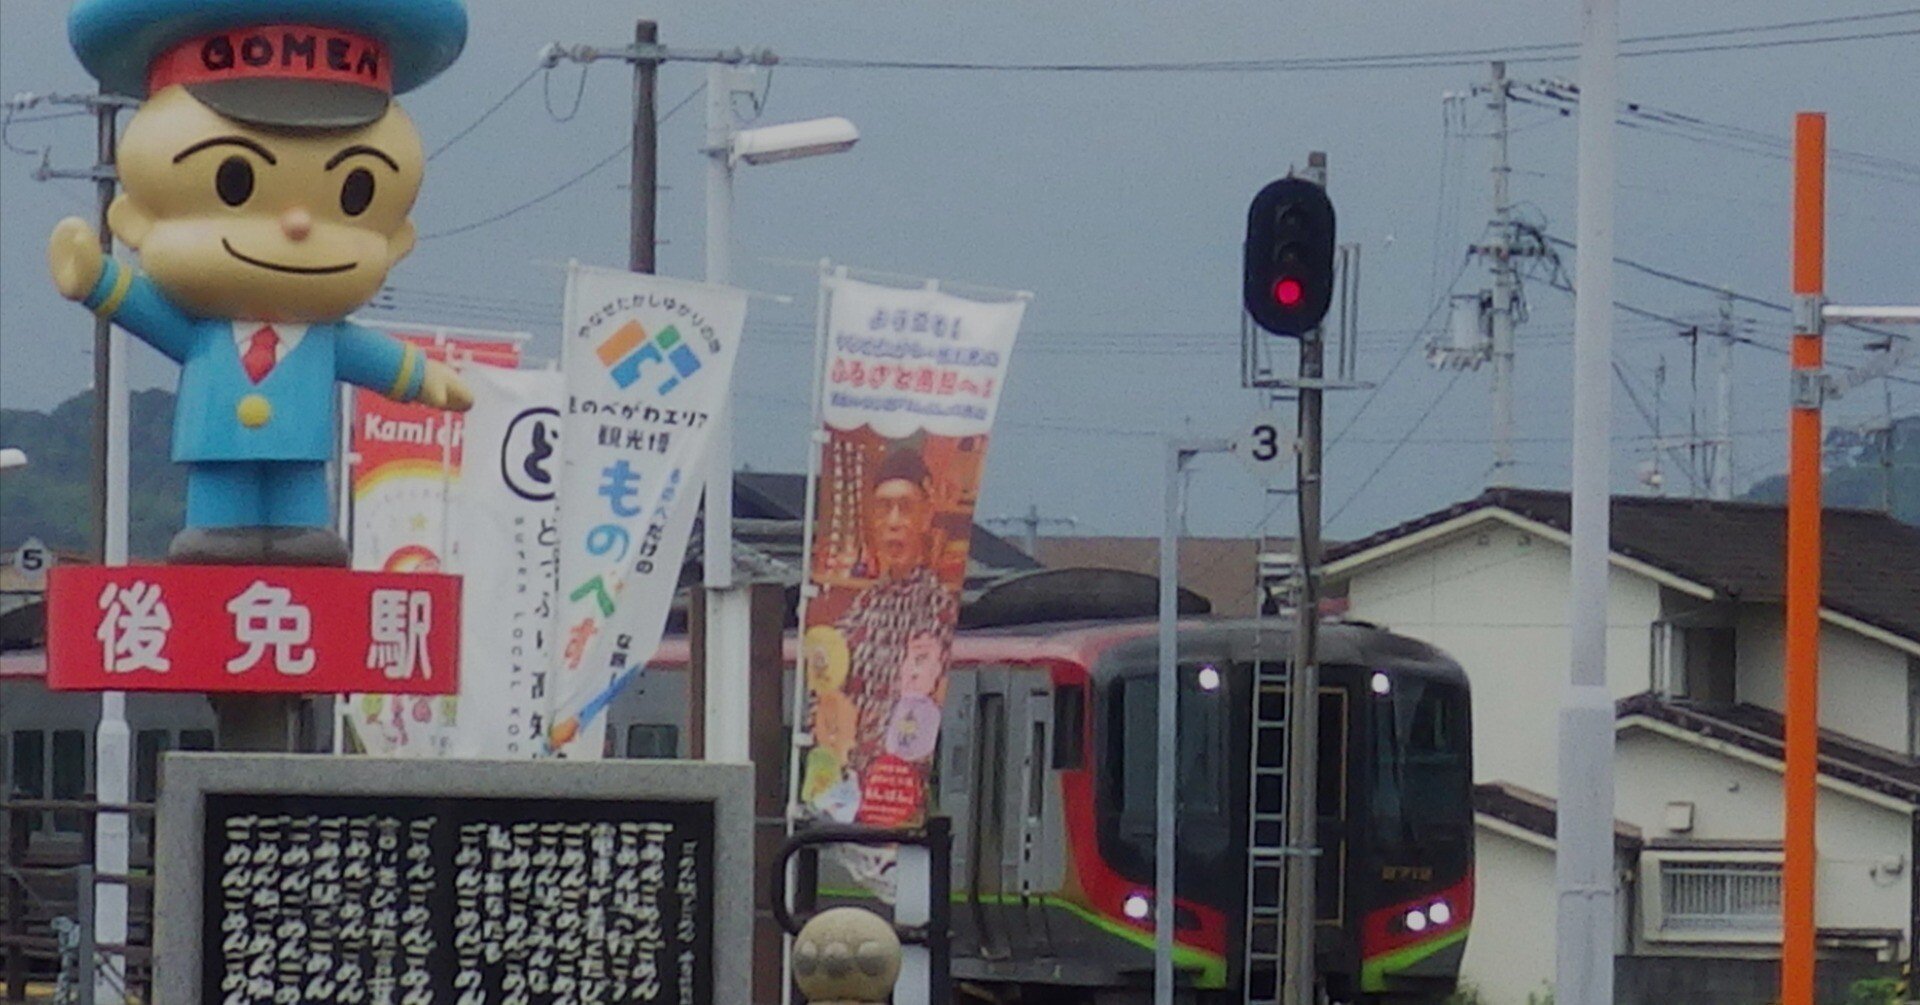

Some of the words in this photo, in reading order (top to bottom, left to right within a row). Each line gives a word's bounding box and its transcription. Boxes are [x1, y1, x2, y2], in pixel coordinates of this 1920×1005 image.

[201, 33, 380, 80] GOMEN
[365, 411, 433, 445] Kami
[1252, 424, 1278, 461] 3
[22, 549, 43, 570] 5
[97, 580, 433, 680] 後免駅
[510, 611, 524, 689] LOCAL
[578, 822, 616, 1005] 電車が着くたび
